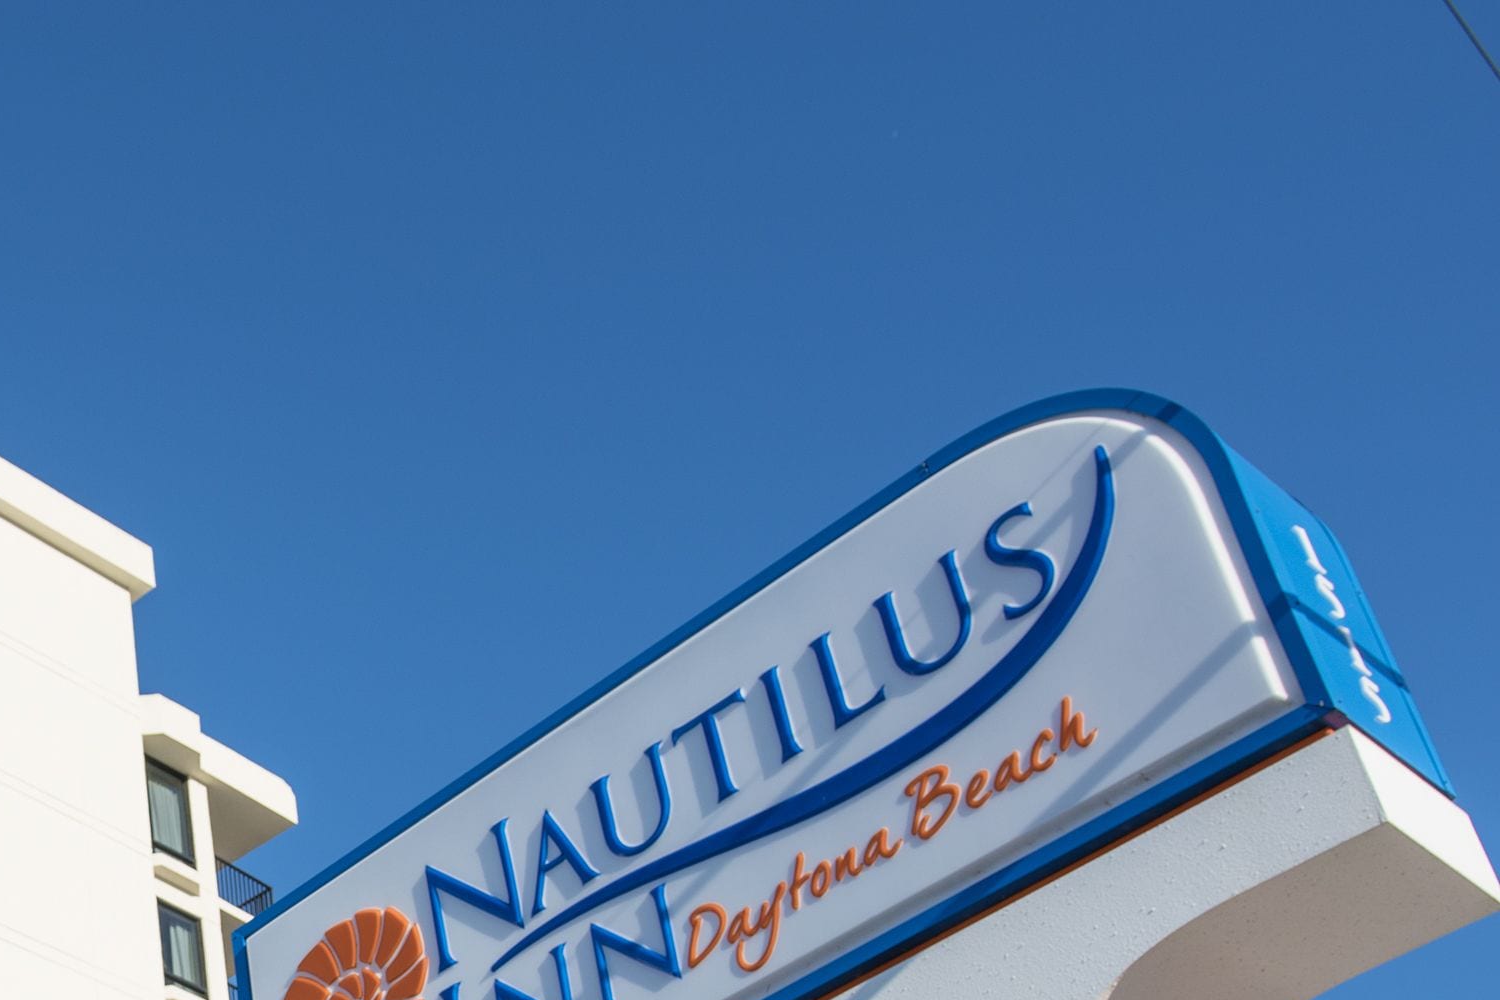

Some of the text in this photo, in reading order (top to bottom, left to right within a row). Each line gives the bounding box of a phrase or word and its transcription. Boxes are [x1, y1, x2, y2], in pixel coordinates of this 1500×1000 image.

[425, 500, 1055, 974] NAUTILUS
[686, 696, 1098, 973] Daytona Beach
